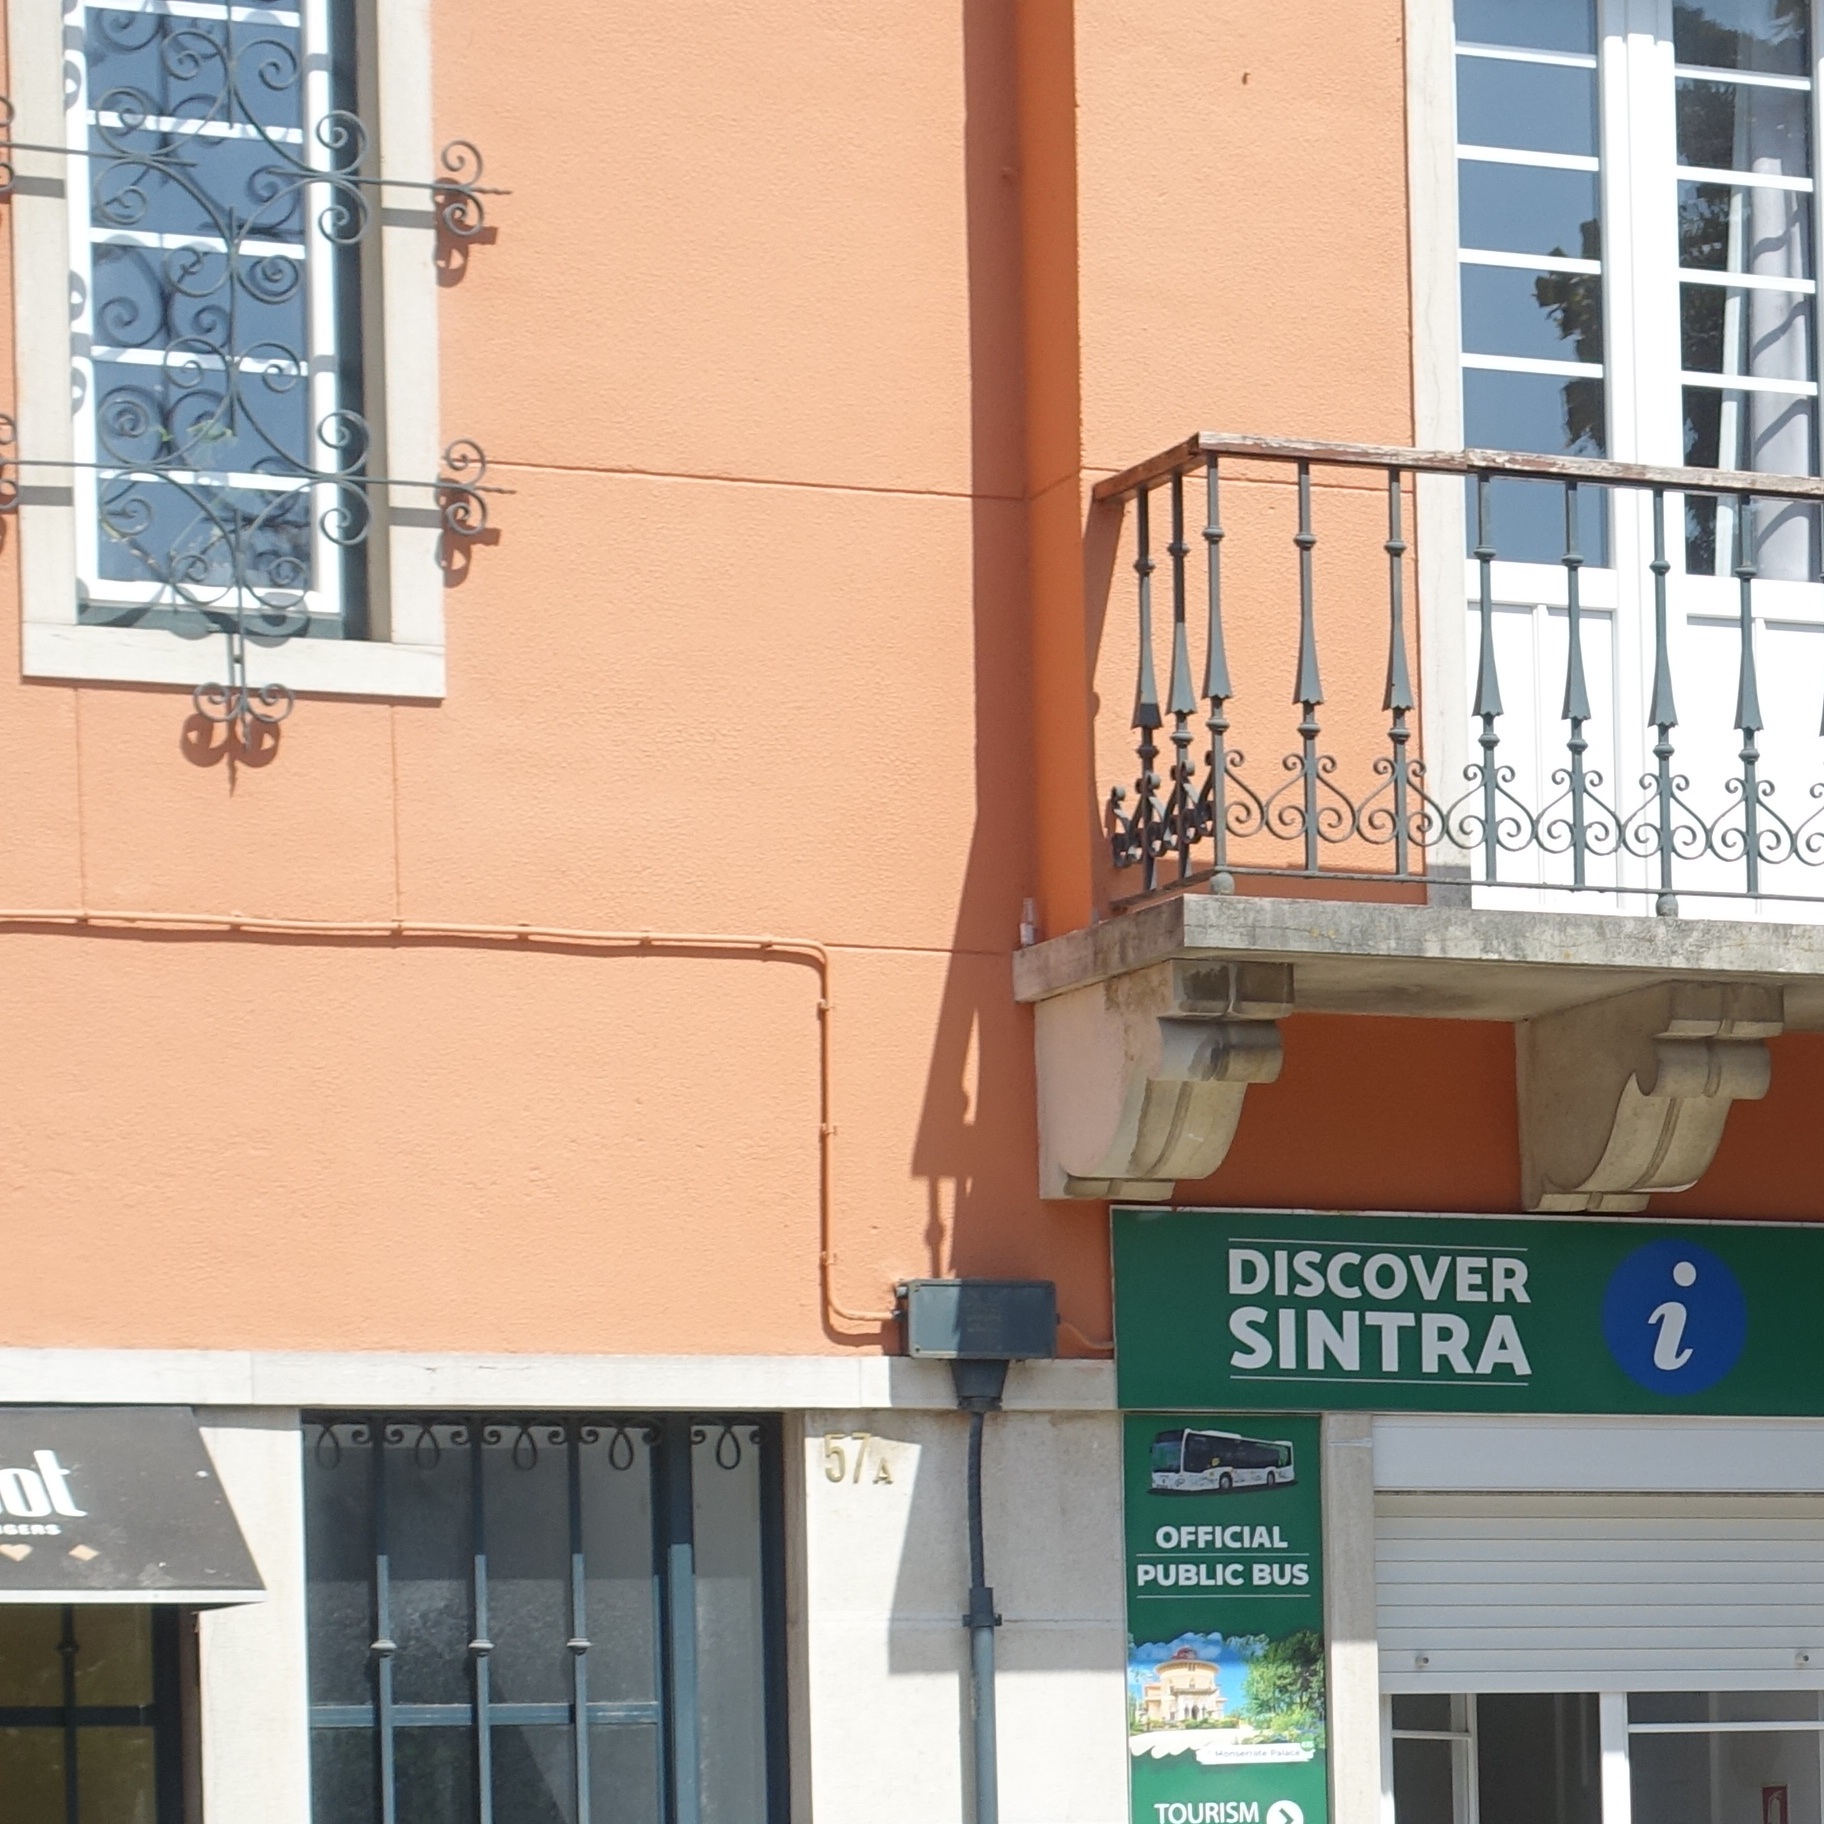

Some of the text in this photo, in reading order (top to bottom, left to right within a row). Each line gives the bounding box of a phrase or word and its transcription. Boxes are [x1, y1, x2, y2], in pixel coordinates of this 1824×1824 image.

[1227, 1248, 1531, 1304] DISCOVER
[1227, 1307, 1532, 1375] SINTRA
[0, 1449, 88, 1517] ot
[0, 1524, 62, 1535] GERS
[1155, 1525, 1288, 1549] OFFICIAL
[1137, 1563, 1310, 1586] PUBLIC BUS
[1271, 1749, 1300, 1757] Palace
[1154, 1801, 1259, 1824] TOURISM
